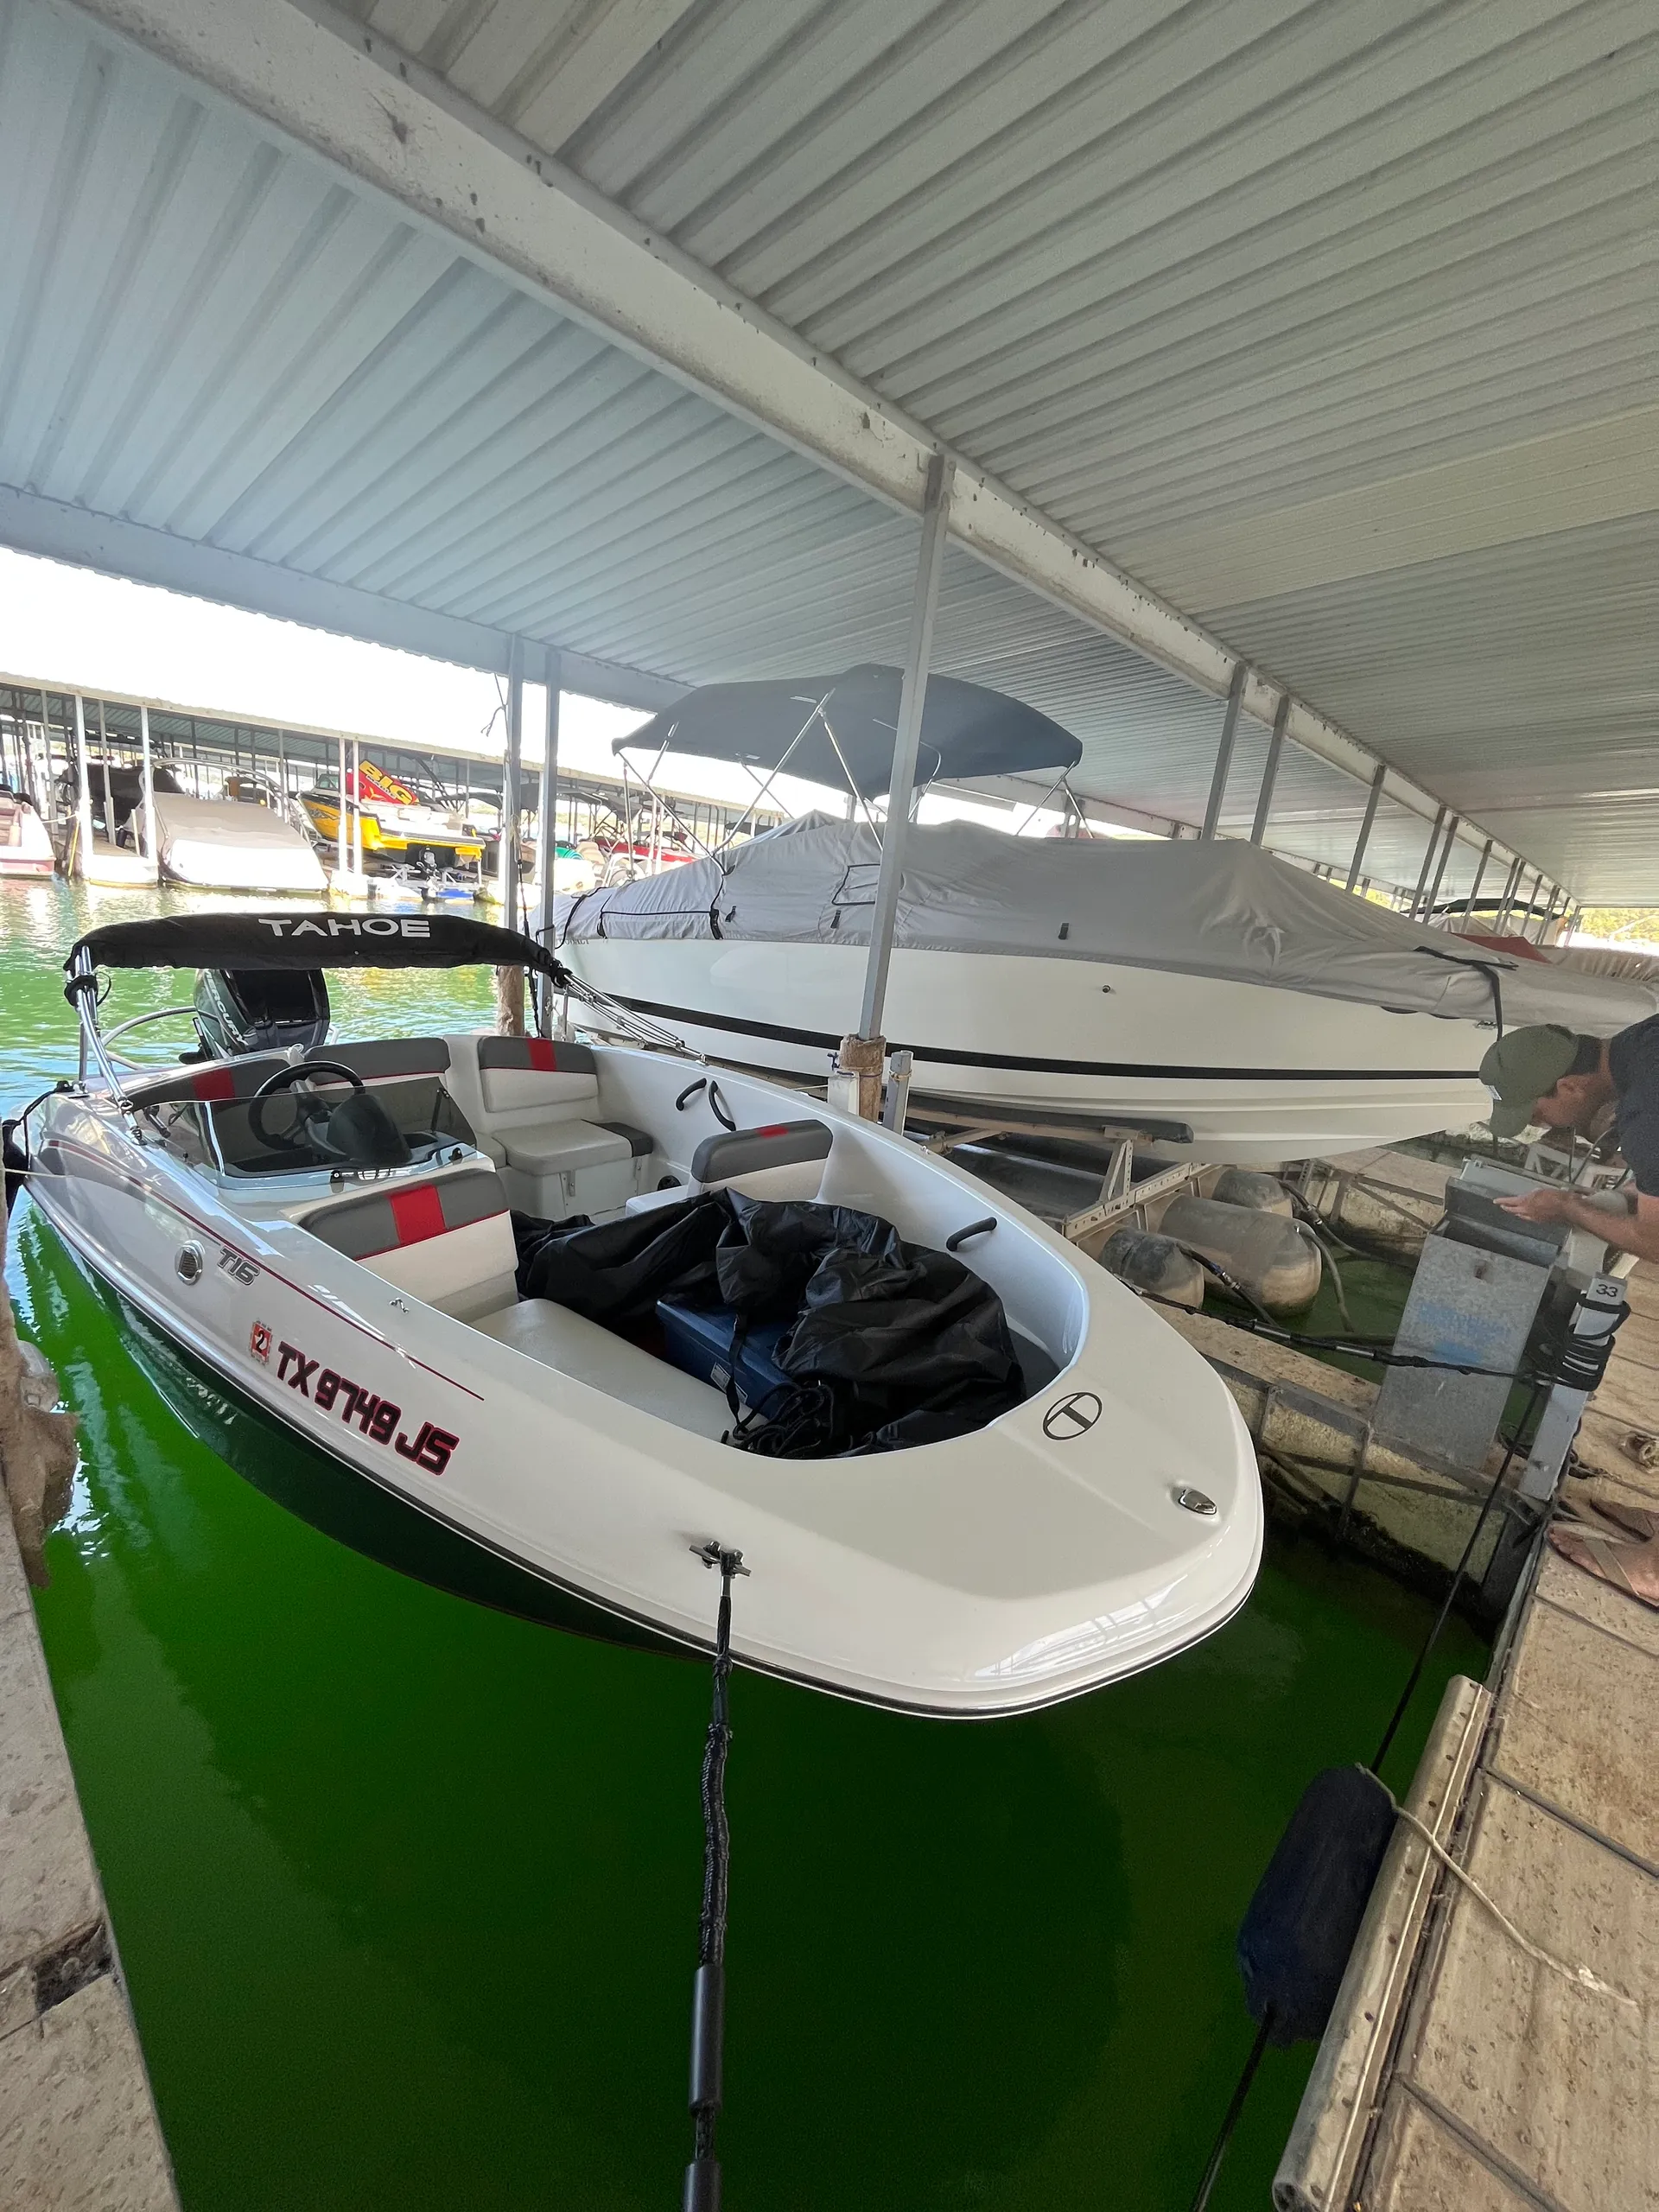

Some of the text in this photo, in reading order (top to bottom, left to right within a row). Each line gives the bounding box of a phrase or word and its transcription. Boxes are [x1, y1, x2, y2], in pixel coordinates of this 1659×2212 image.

[359, 760, 414, 805] BIG
[258, 918, 431, 938] TAHOE
[217, 1245, 260, 1286] T16
[1596, 1283, 1618, 1298] 33
[256, 1330, 265, 1354] 2
[276, 1340, 460, 1476] TX 9749 JS
